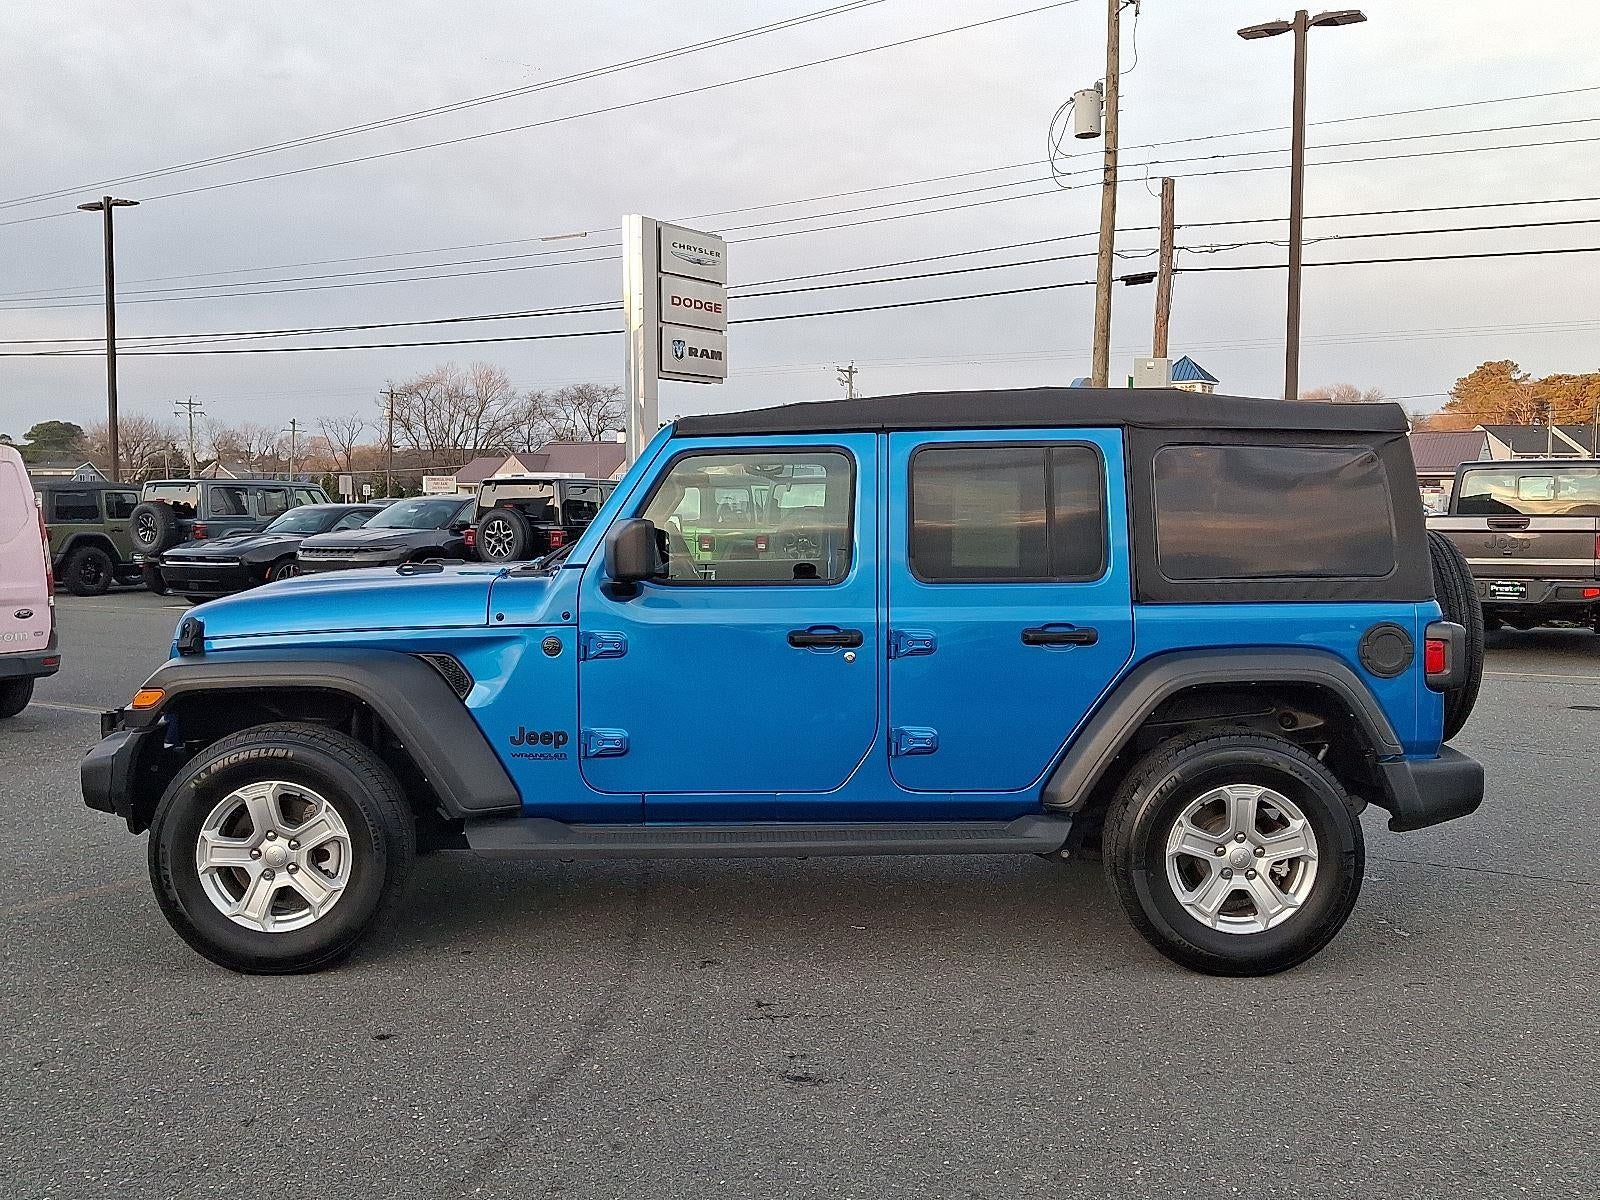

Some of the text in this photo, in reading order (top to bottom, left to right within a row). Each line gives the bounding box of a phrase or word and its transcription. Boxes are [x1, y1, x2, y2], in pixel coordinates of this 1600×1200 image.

[672, 242, 720, 257] CHRYSLER
[671, 296, 722, 313] DODGE
[688, 347, 722, 360] RAM
[510, 726, 568, 748] Jeep
[210, 748, 288, 774] MICHELIN
